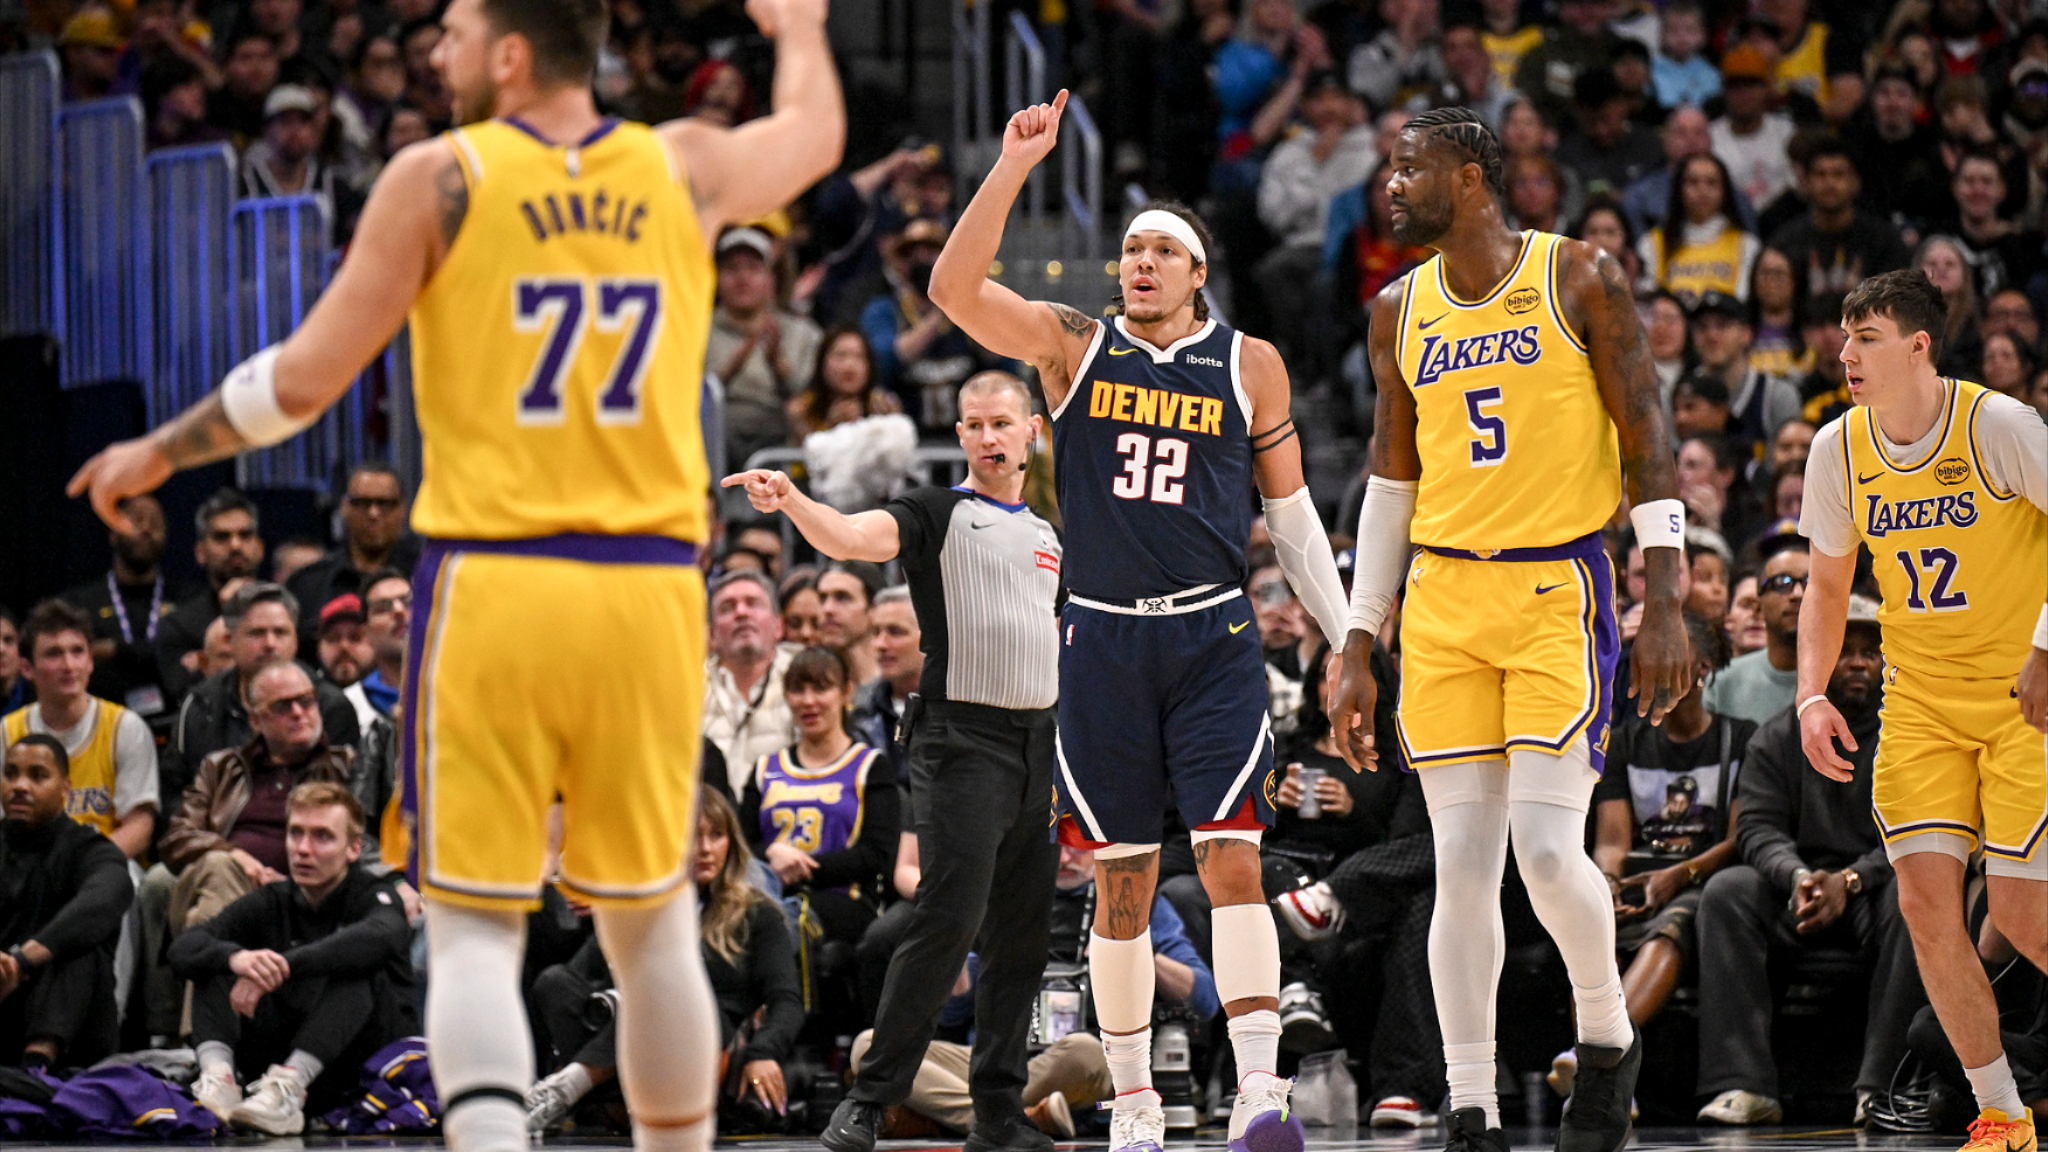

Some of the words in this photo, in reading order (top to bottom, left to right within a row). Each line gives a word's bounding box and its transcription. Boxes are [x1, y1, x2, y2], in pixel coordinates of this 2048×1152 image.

[1508, 294, 1538, 306] bibigo
[514, 278, 663, 420] 77
[1186, 353, 1224, 368] ibotta
[1413, 325, 1542, 388] LAKERS
[1088, 379, 1225, 437] DENVER
[1463, 385, 1507, 468] 5
[1112, 431, 1191, 505] 32
[1937, 465, 1967, 476] bibigo
[1669, 513, 1680, 534] 5
[1865, 490, 1980, 538] LAKERS
[1896, 546, 1970, 613] 12
[772, 806, 824, 855] 23
